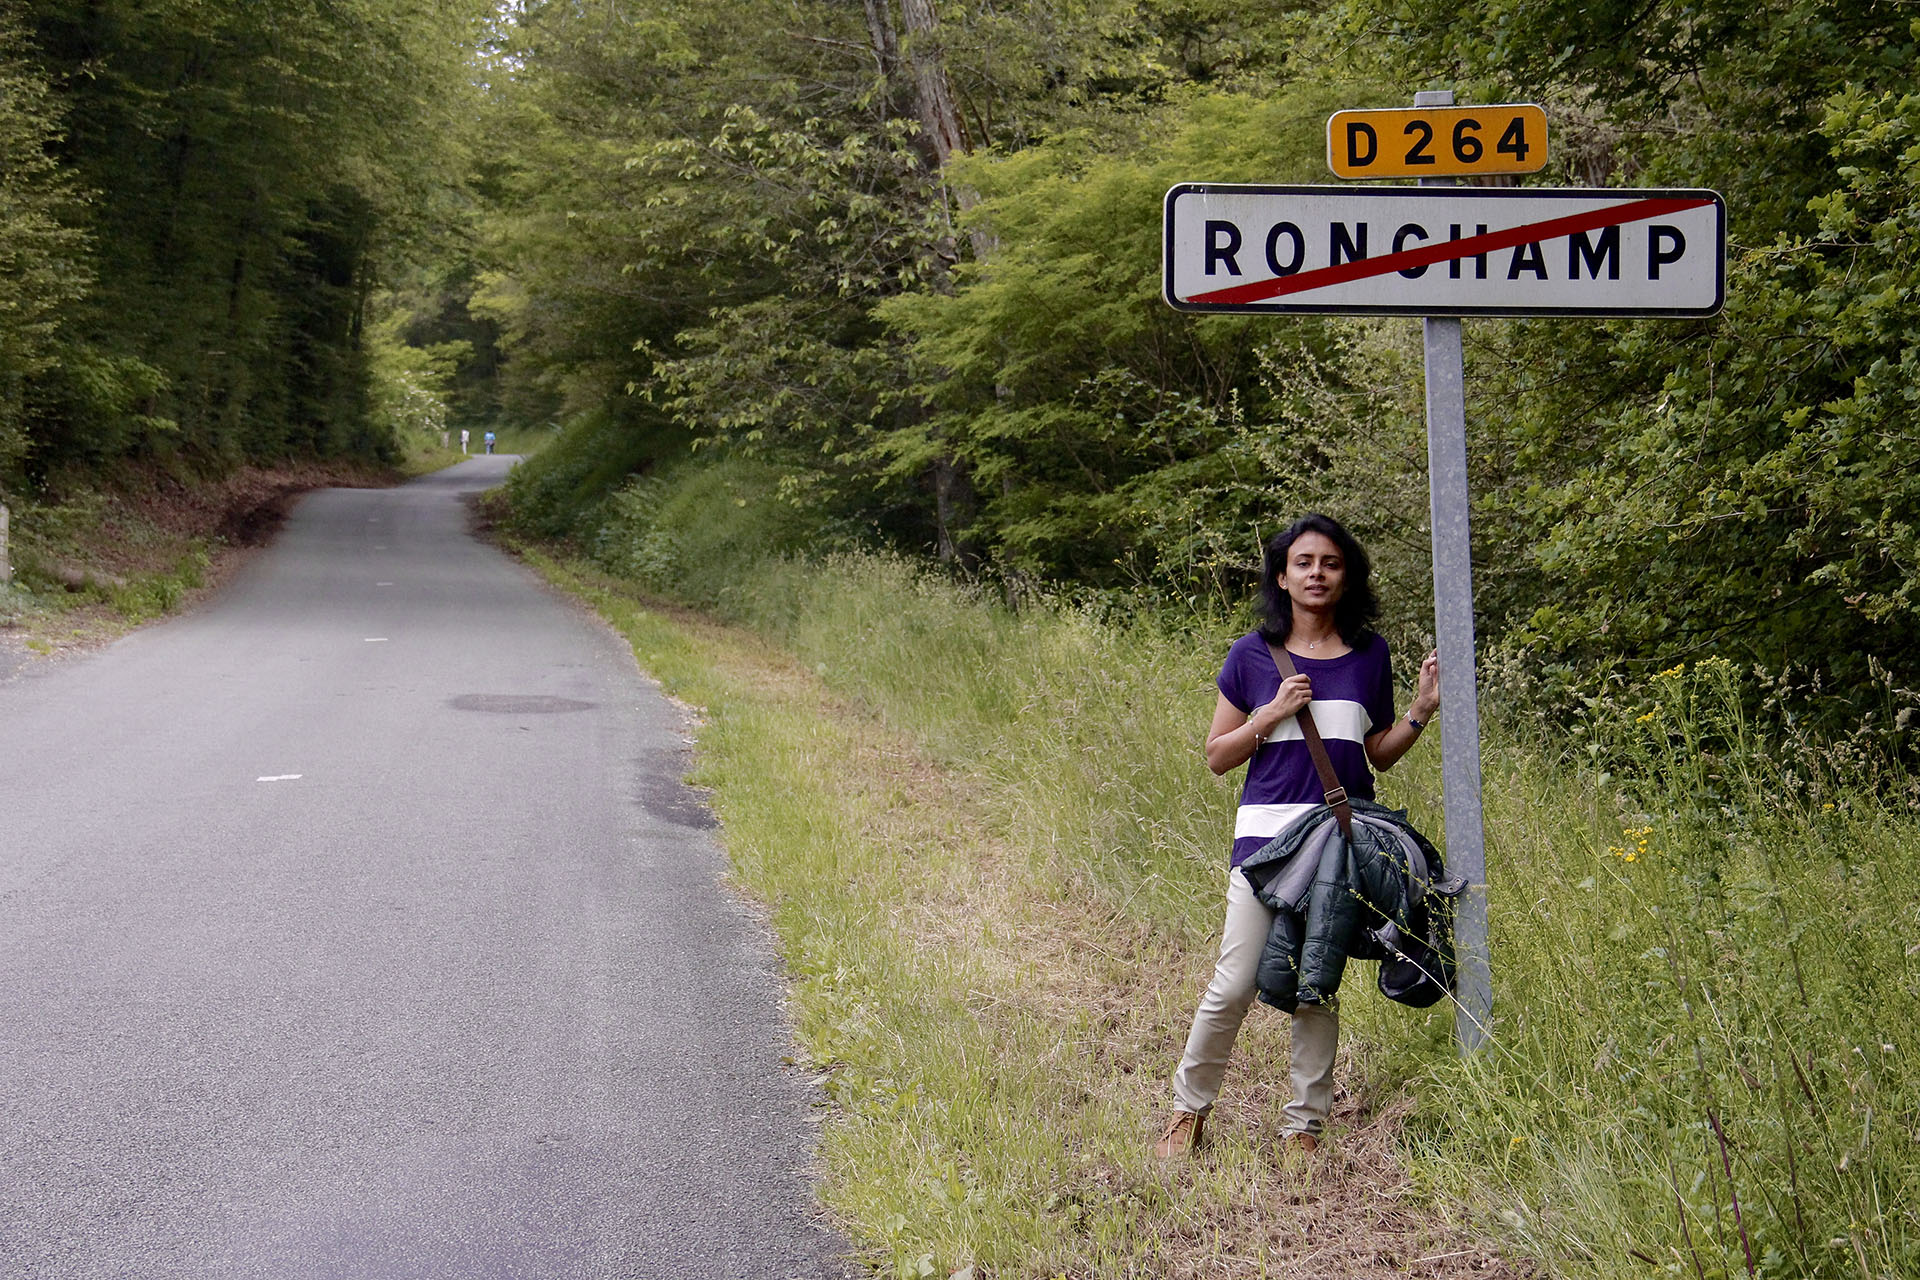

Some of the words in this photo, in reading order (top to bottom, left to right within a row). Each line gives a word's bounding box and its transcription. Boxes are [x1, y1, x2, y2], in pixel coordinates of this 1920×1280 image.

[1346, 122, 1378, 168] D
[1403, 117, 1530, 165] 264
[1204, 219, 1687, 281] RONCHAMP
